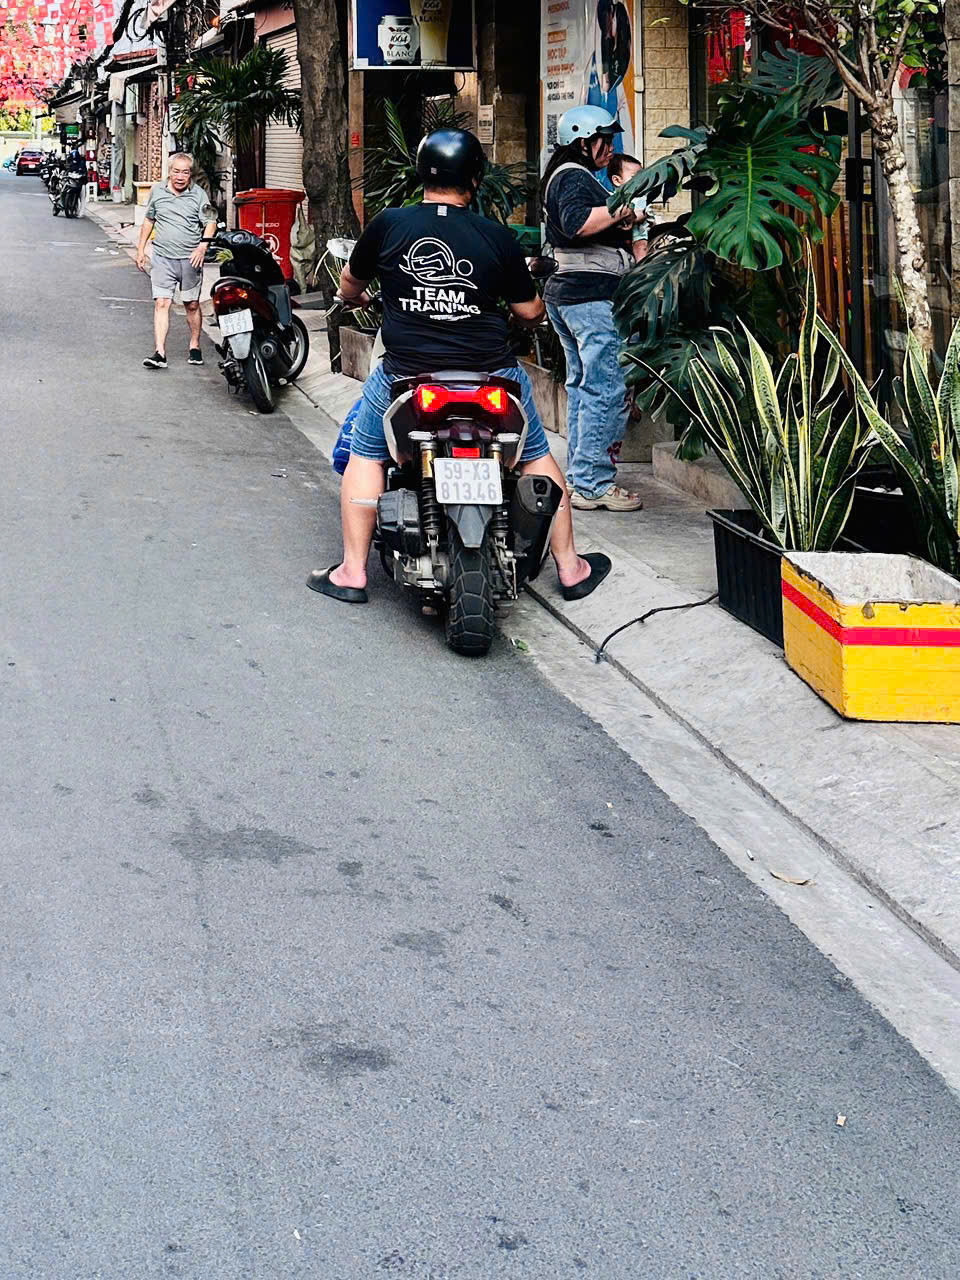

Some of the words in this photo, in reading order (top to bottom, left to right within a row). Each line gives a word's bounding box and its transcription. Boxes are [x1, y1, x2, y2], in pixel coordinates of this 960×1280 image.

[412, 286, 465, 304] TEAM
[444, 462, 490, 480] 59-X3
[441, 482, 497, 500] 813.46
